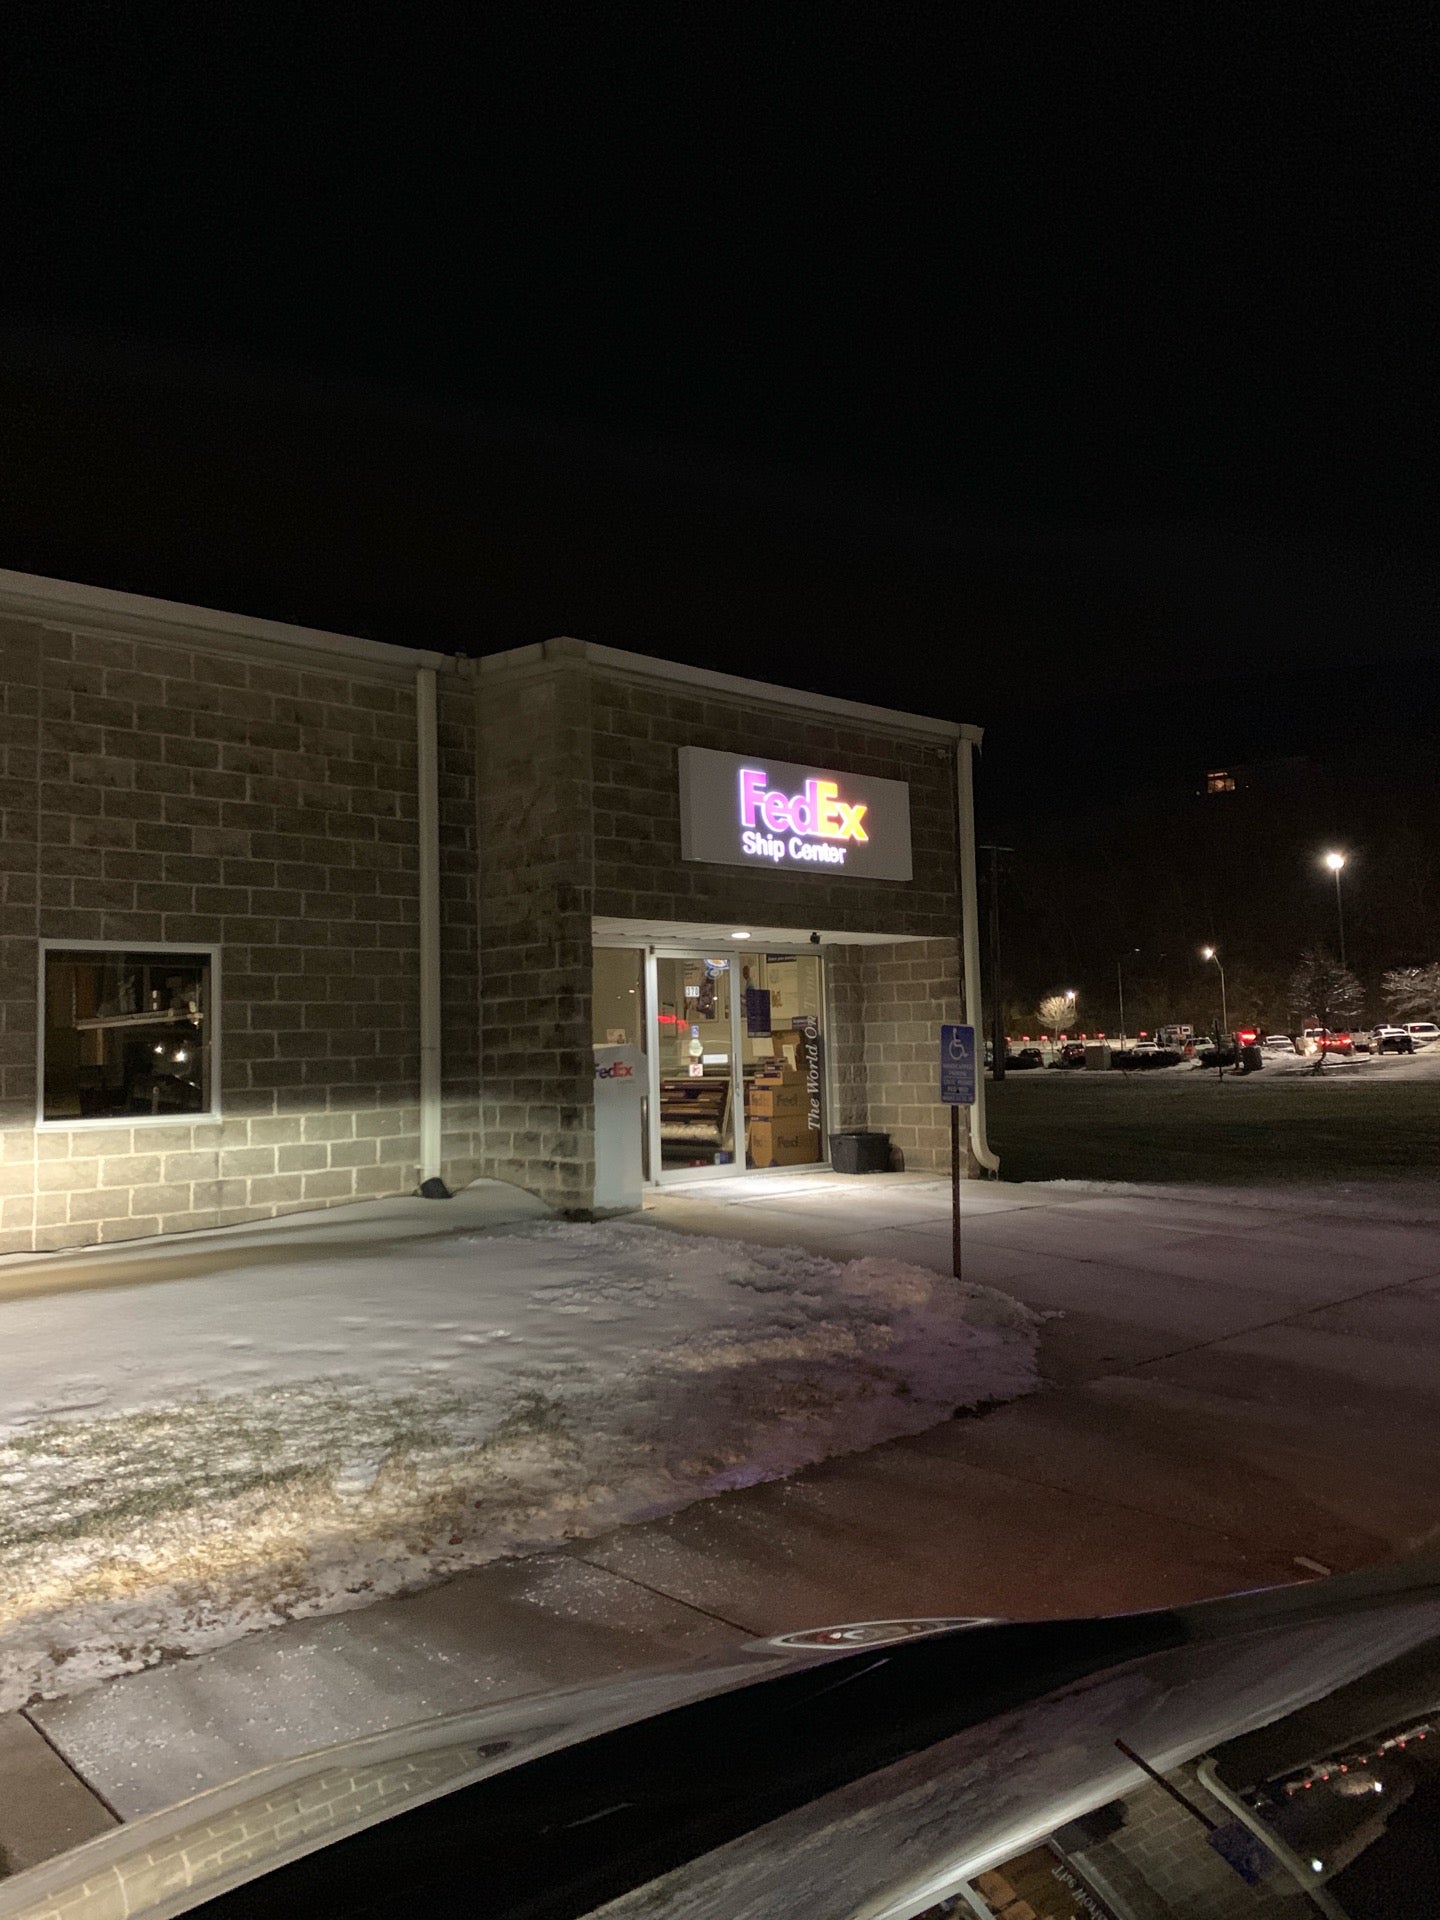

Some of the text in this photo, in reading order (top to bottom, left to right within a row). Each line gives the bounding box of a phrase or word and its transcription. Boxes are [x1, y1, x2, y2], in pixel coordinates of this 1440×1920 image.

[739, 768, 869, 842] FedEx
[742, 831, 847, 864] Ship Center
[804, 1015, 818, 1039] On
[806, 1044, 819, 1093] World
[808, 1098, 821, 1131] The
